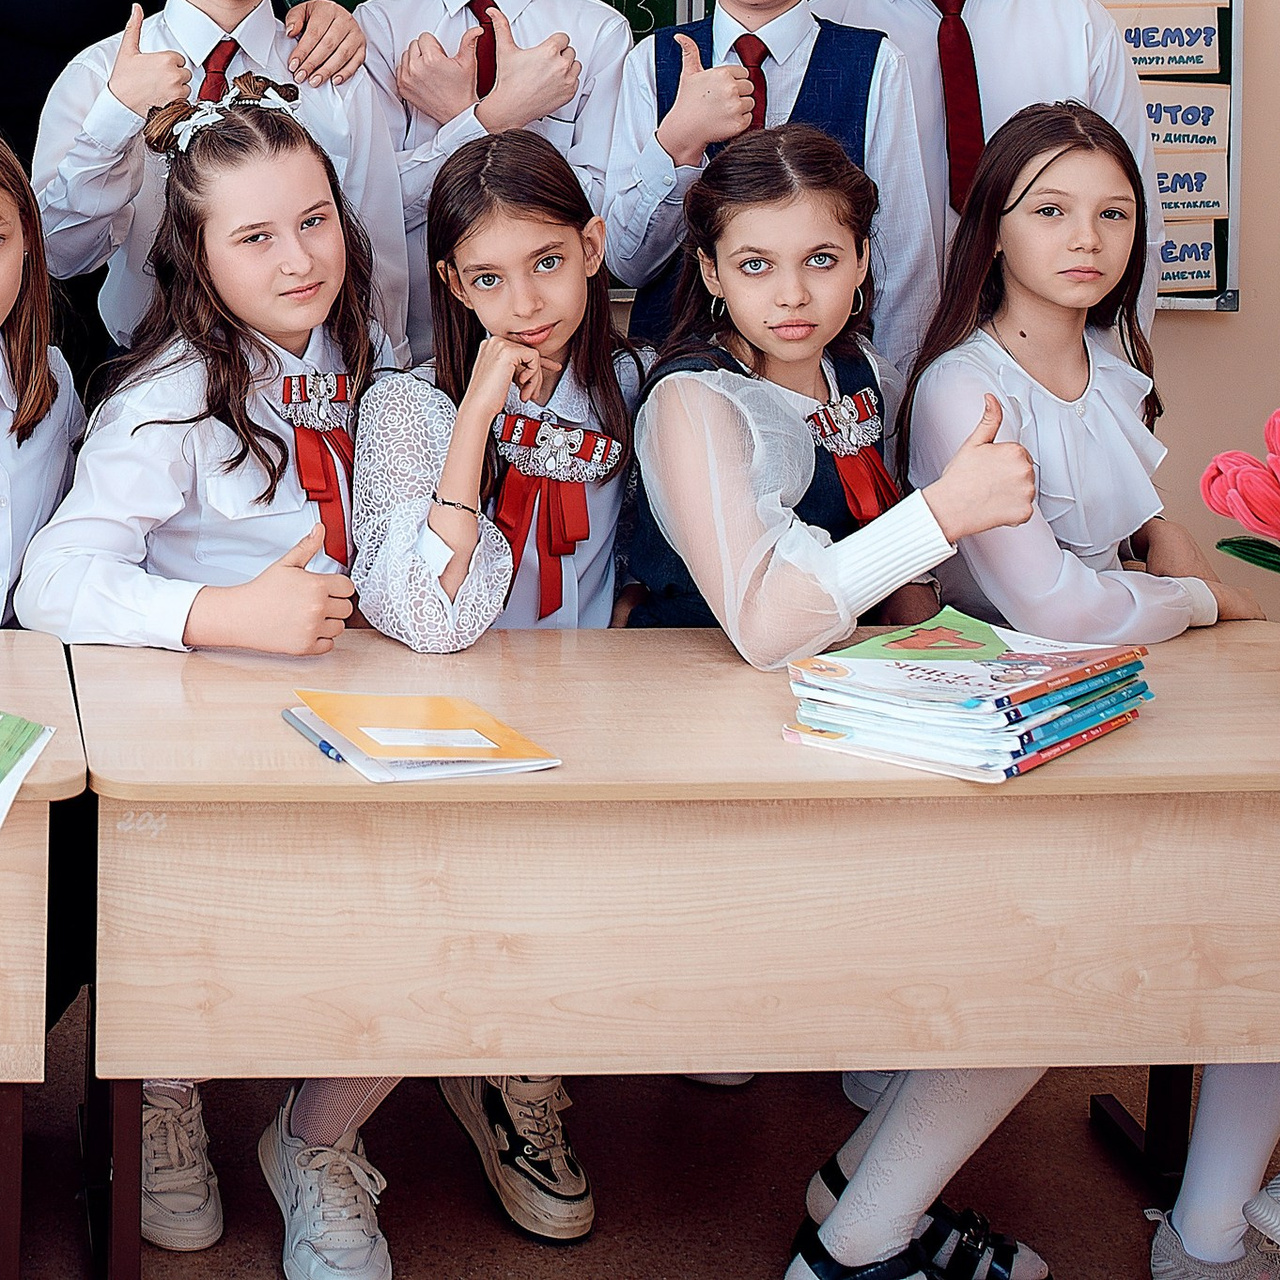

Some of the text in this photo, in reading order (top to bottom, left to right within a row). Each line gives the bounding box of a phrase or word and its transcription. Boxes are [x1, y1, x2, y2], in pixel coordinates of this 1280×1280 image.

[1125, 27, 1217, 48] ЧЕМУ?
[1167, 55, 1204, 65] МАМЕ
[1146, 103, 1214, 126] ЧТО?
[1163, 133, 1217, 145] ДИПЛОМ
